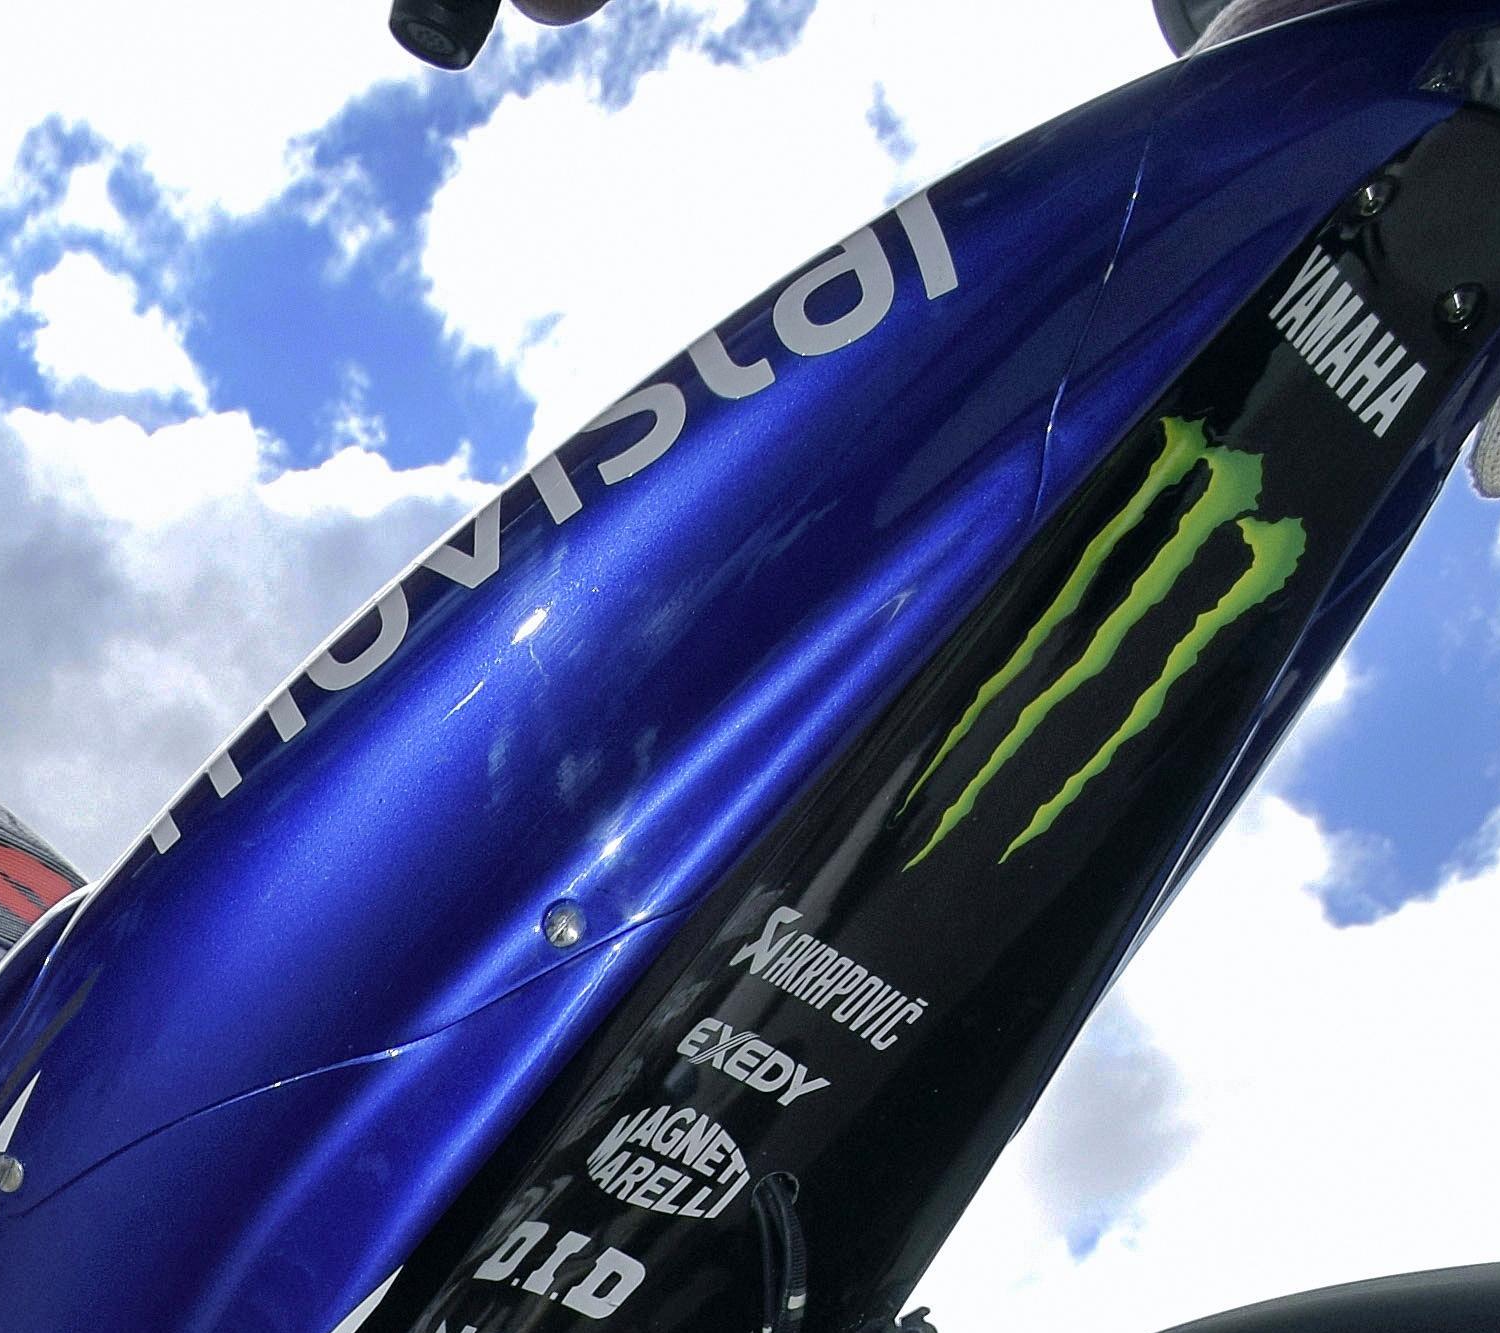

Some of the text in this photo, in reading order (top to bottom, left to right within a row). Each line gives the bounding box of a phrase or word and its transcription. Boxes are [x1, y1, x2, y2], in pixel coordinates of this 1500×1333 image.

[1268, 244, 1431, 438] YAMAHA
[150, 190, 958, 855] ovistar
[677, 1017, 830, 1105] EXEDY
